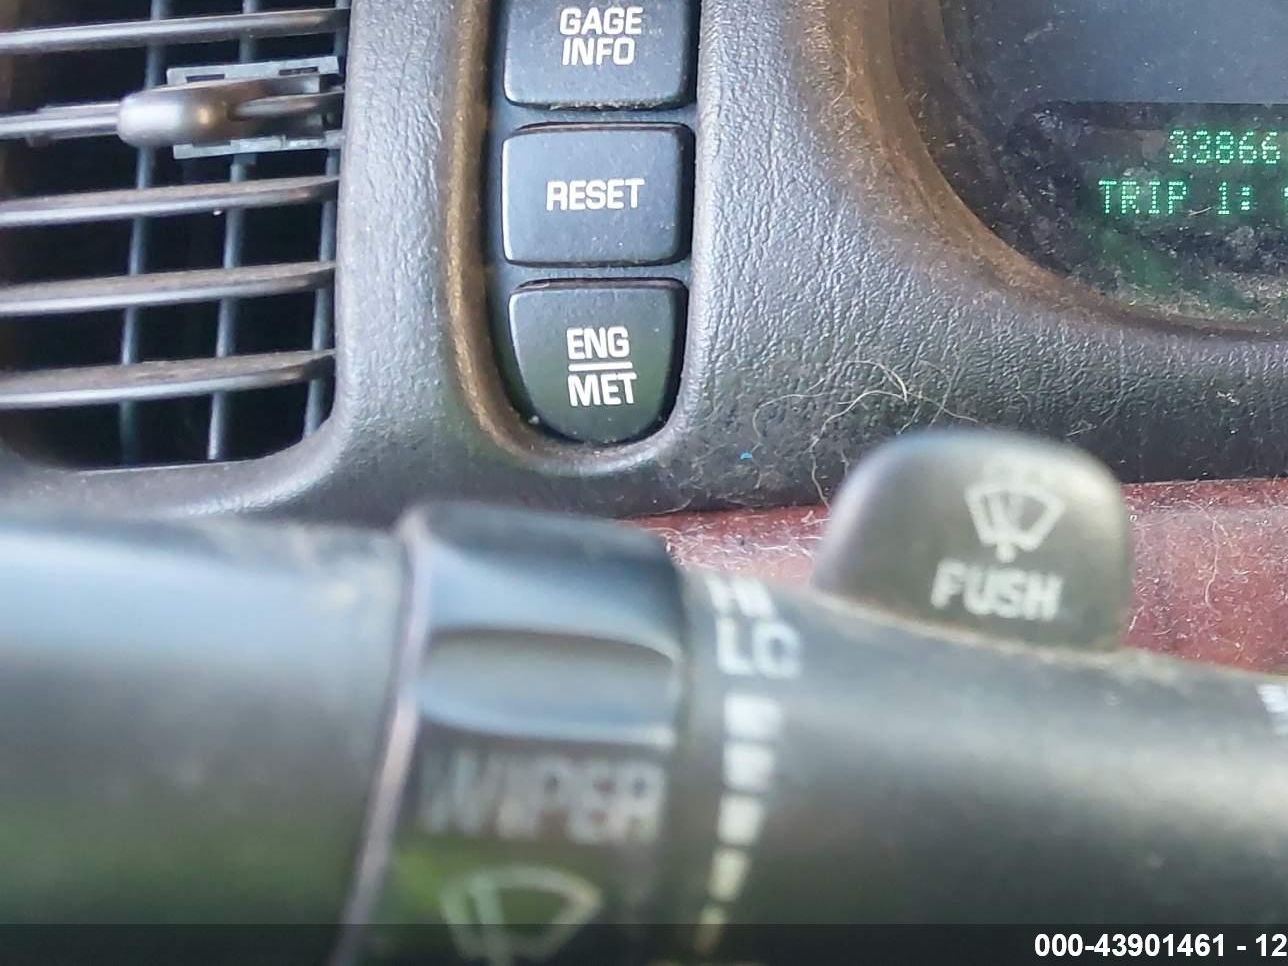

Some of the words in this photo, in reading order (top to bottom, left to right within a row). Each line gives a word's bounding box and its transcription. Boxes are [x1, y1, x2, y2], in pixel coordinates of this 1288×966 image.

[559, 5, 644, 36] GAGE
[562, 36, 635, 69] INFO
[546, 177, 646, 212] RESET
[1099, 179, 1187, 215] TRIP
[566, 326, 630, 360] ENG
[567, 371, 638, 407] MET
